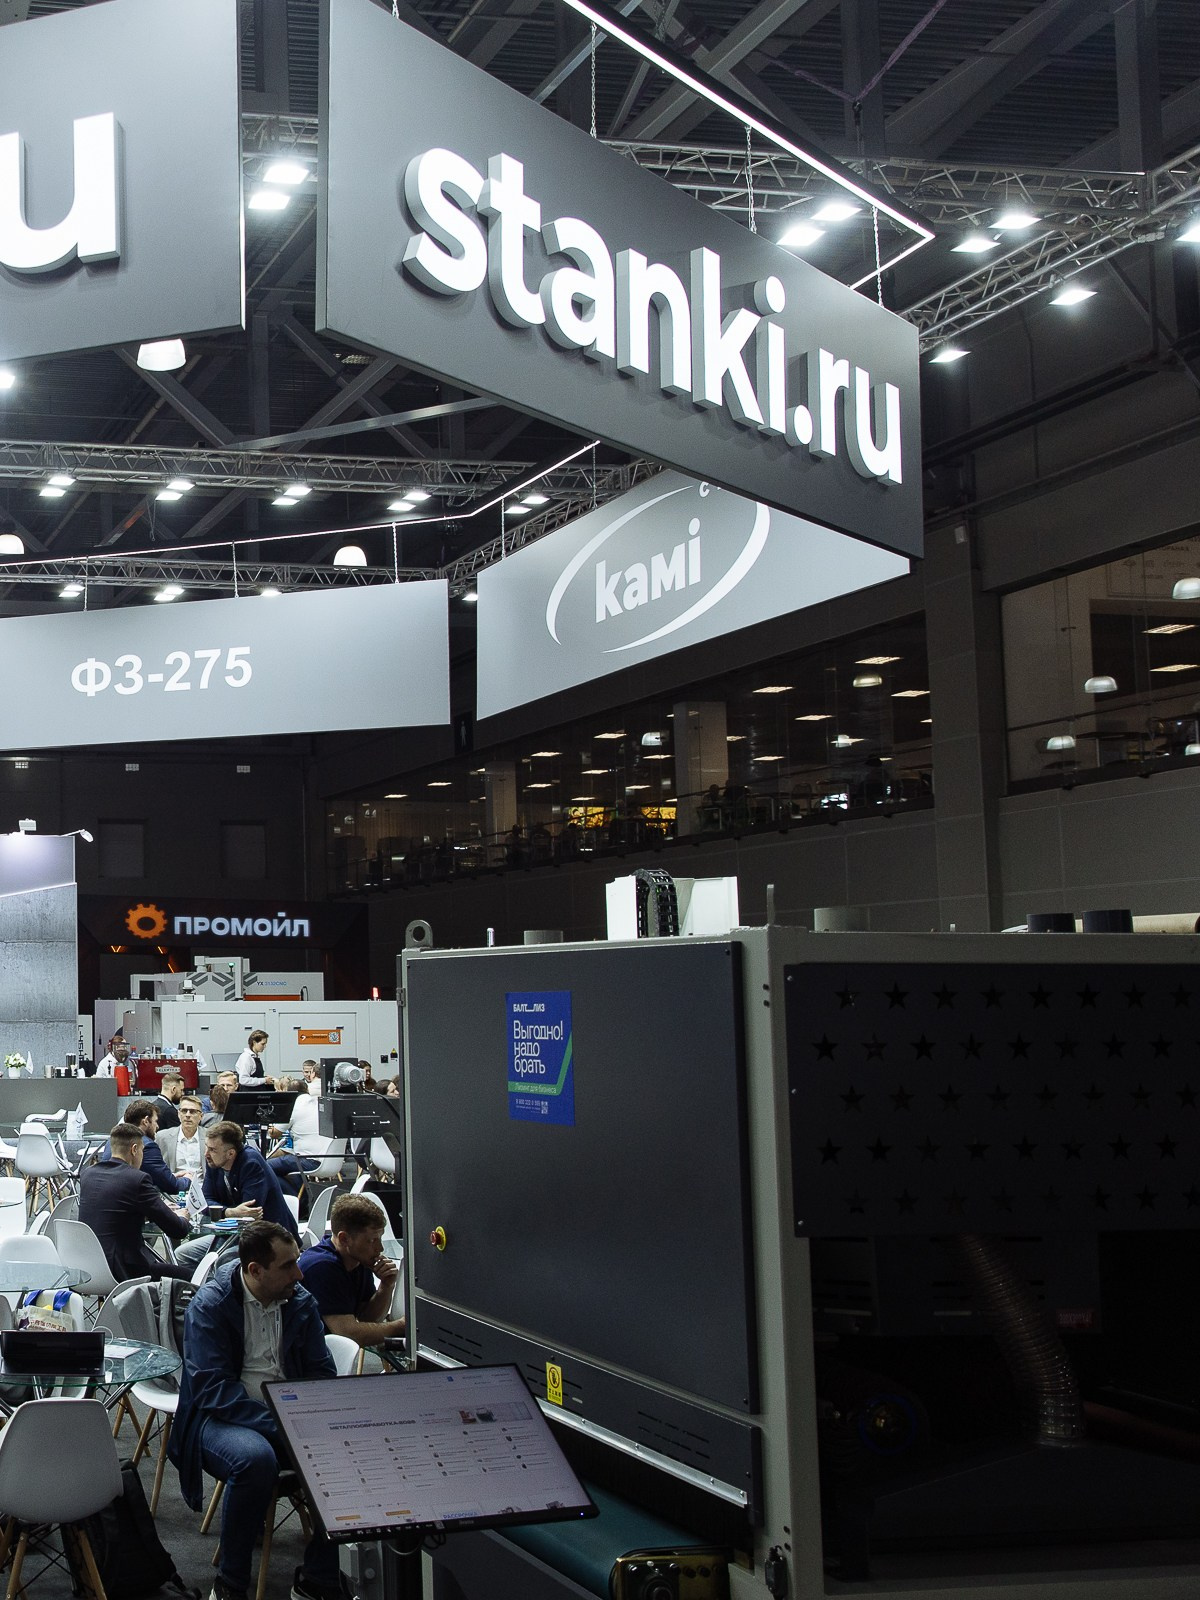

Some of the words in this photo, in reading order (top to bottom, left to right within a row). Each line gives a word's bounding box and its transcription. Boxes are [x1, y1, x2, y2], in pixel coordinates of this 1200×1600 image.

[402, 147, 905, 486] stanki.ru
[173, 912, 310, 938] ПРОМОЙЛ
[513, 1020, 563, 1040] Выгодно!
[513, 1042, 540, 1057] надо
[514, 1055, 546, 1078] брать
